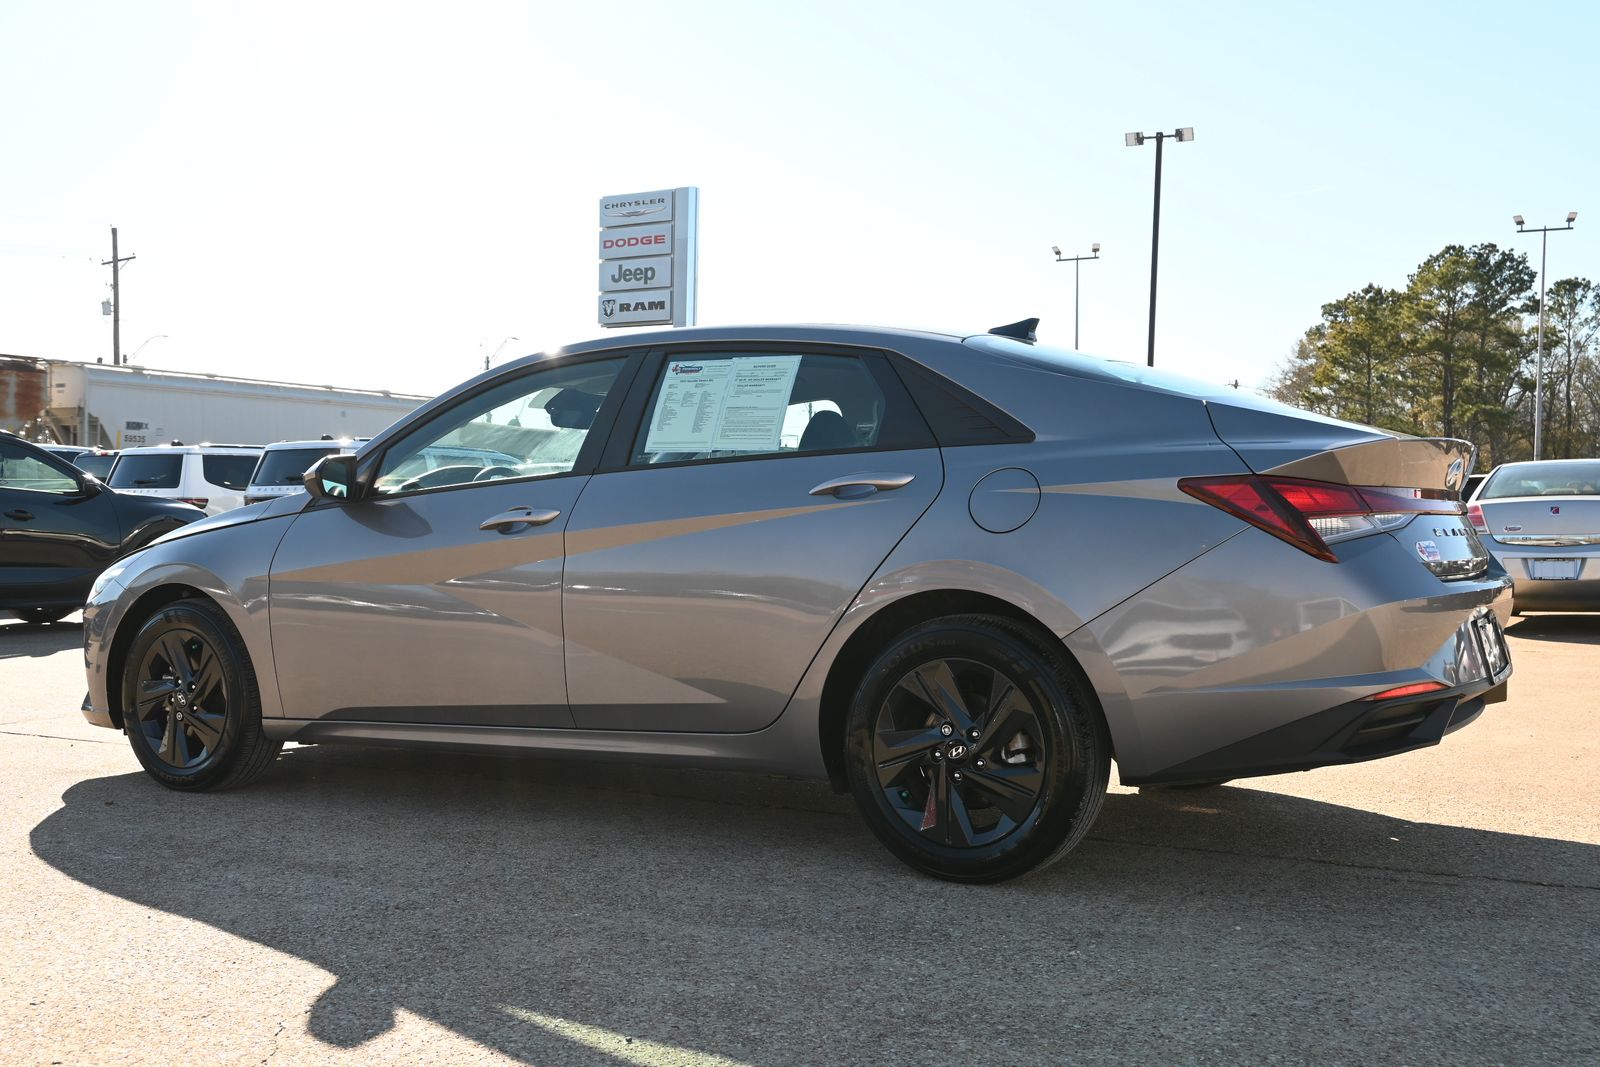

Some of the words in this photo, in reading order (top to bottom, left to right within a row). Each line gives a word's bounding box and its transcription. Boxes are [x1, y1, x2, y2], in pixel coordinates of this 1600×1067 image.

[604, 198, 665, 210] CHRYSLER
[603, 234, 666, 249] DODGE
[611, 264, 656, 285] Jeep
[619, 301, 665, 312] RAM
